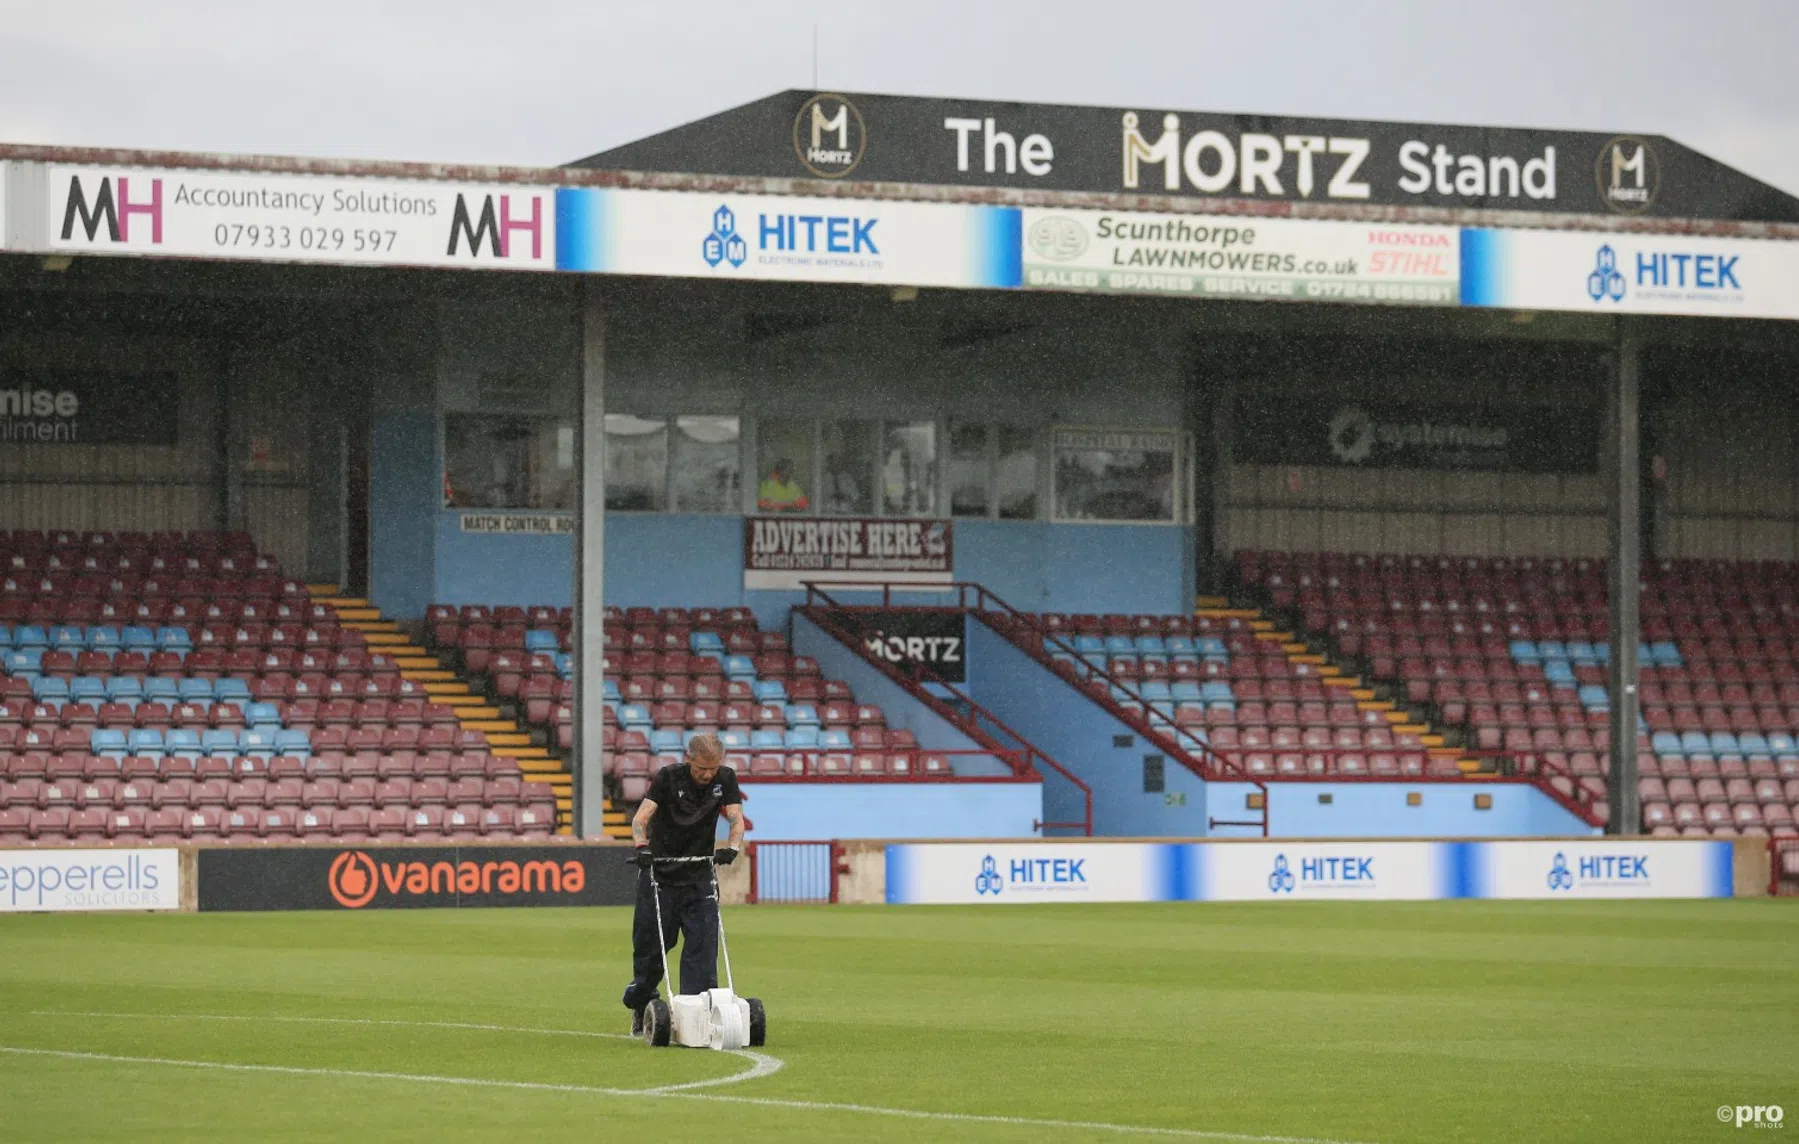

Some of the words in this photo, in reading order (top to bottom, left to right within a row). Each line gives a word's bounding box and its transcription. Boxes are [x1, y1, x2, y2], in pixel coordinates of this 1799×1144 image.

[944, 117, 1054, 176] The
[1121, 111, 1371, 199] MORTZ
[1397, 140, 1557, 200] Stand
[174, 183, 324, 215] Accountancy
[333, 190, 437, 217] Solutions
[214, 224, 292, 248] 07933
[300, 229, 345, 251] 029
[353, 231, 398, 252] 597
[759, 214, 881, 255] HITEK
[1096, 217, 1256, 248] Scunthorpe
[1368, 230, 1452, 248] HONDA
[1113, 247, 1359, 276] LAWNMOWERS.co.uk
[1368, 250, 1450, 277] STIHL
[1636, 251, 1742, 290] HITEK
[1028, 269, 1100, 289] SALES
[1108, 273, 1195, 292] SPARES
[1203, 278, 1294, 297] SERVICE
[463, 516, 500, 530] MATCH
[504, 517, 554, 532] CONTROL
[752, 520, 862, 553] ADVERTISE
[867, 523, 921, 554] HERE
[380, 861, 585, 895] vanarama
[1010, 859, 1086, 882] HITEK
[1301, 857, 1373, 880] HITEK
[1580, 855, 1648, 878] HITEK
[65, 890, 159, 905] SOLICITORS
